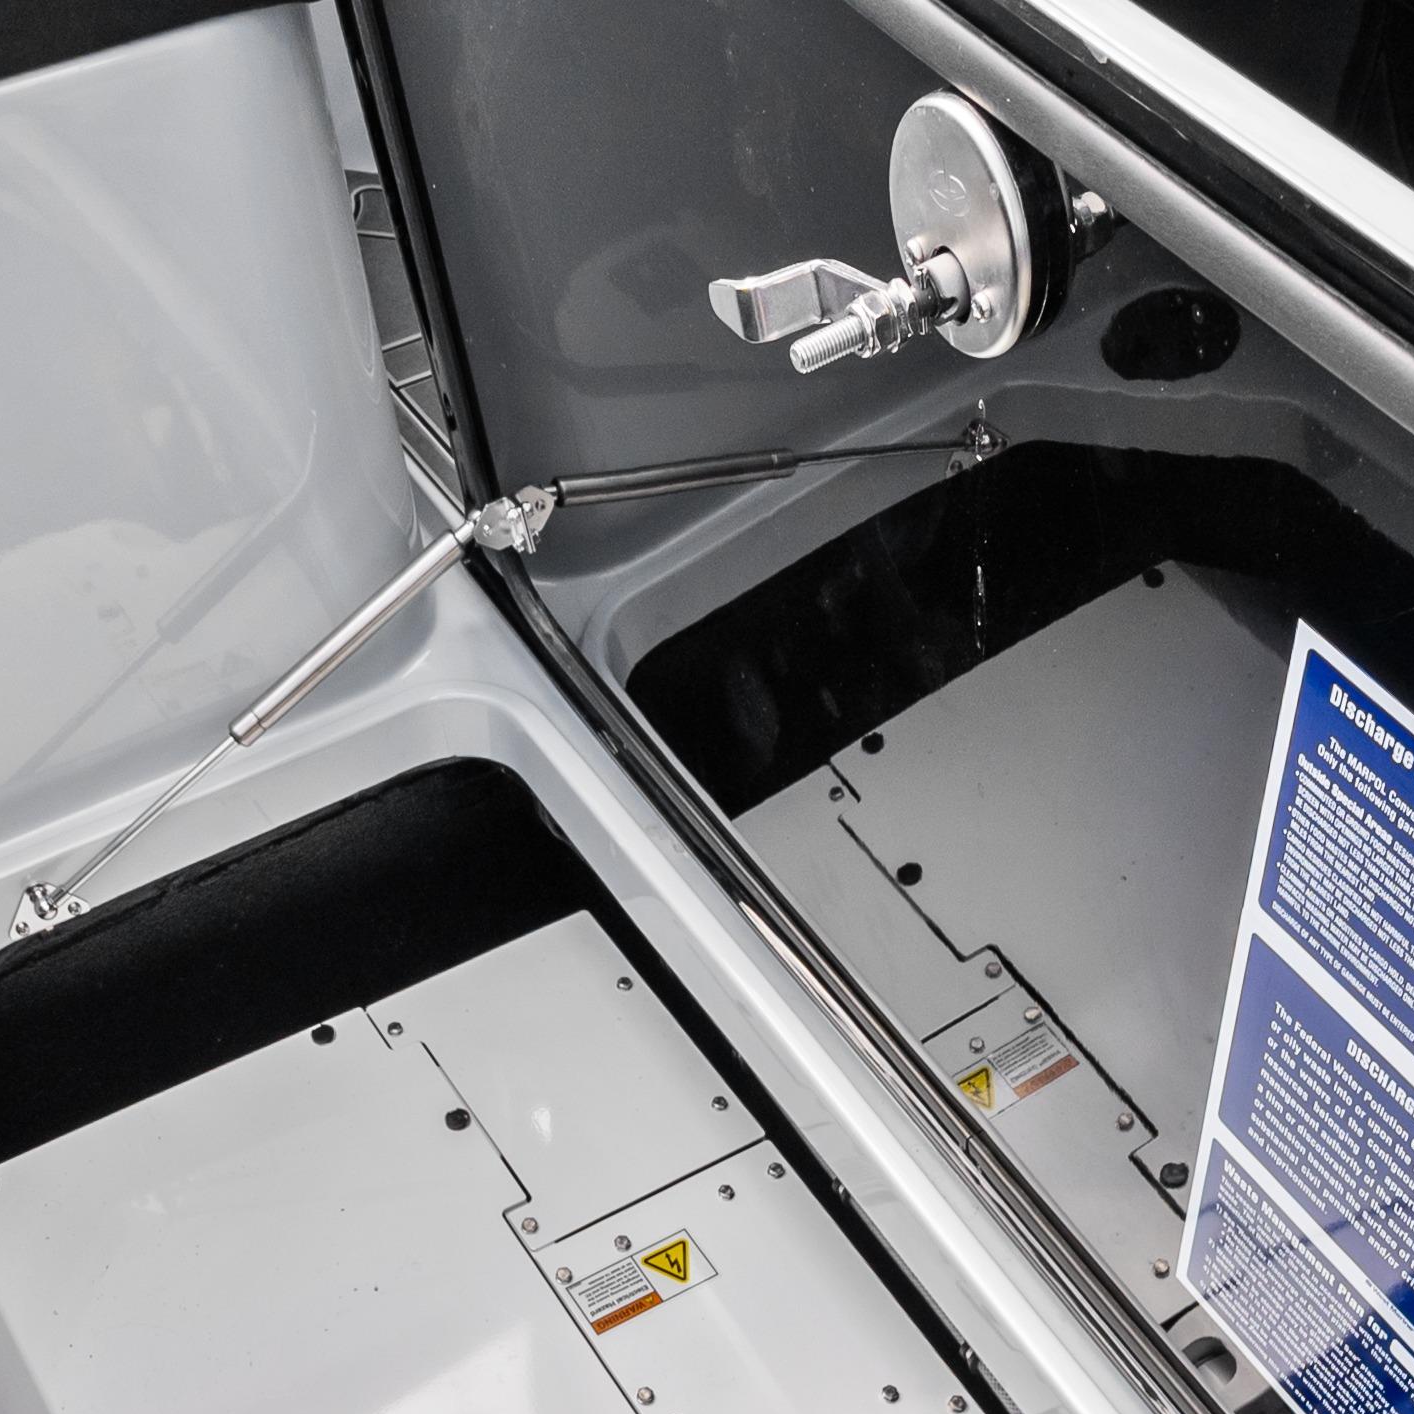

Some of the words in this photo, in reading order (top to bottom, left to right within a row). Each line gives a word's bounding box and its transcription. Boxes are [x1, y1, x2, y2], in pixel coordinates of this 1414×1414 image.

[1328, 682, 1414, 770] Discharge
[1328, 735, 1347, 760] The
[1345, 752, 1387, 796] MARPOL
[1316, 742, 1339, 770] Only
[1337, 761, 1354, 783] the
[1353, 775, 1397, 822] following
[1262, 1051, 1309, 1102] resources
[1311, 1099, 1360, 1156] belonging
[1363, 1152, 1378, 1175] to,
[1266, 1035, 1279, 1050] or
[1279, 1047, 1296, 1070] the
[1298, 1067, 1332, 1105] waters
[1333, 1103, 1346, 1119] of
[1346, 1115, 1364, 1138] the
[1269, 1019, 1282, 1034] or
[1282, 1031, 1302, 1056] oily
[1302, 1051, 1332, 1085] waste
[1332, 1079, 1353, 1106] into
[1353, 1104, 1367, 1119] or
[1366, 1116, 1393, 1147] upon
[1393, 1142, 1412, 1165] the
[1274, 1000, 1293, 1026] The
[1292, 1020, 1332, 1064] Federal
[1332, 1057, 1363, 1094] Water
[1362, 1089, 1409, 1142] Pollution
[1259, 1067, 1320, 1132] management
[1319, 1128, 1363, 1176] authority
[1362, 1173, 1375, 1188] of
[1374, 1183, 1392, 1206] the
[616, 1284, 649, 1304] Electrical
[1223, 1158, 1259, 1204] Waste
[1260, 1199, 1336, 1287] Management
[1336, 1282, 1365, 1318] Plan
[1365, 1314, 1388, 1340] for
[589, 1301, 615, 1317] Hazard
[596, 1300, 646, 1330] WARNING
